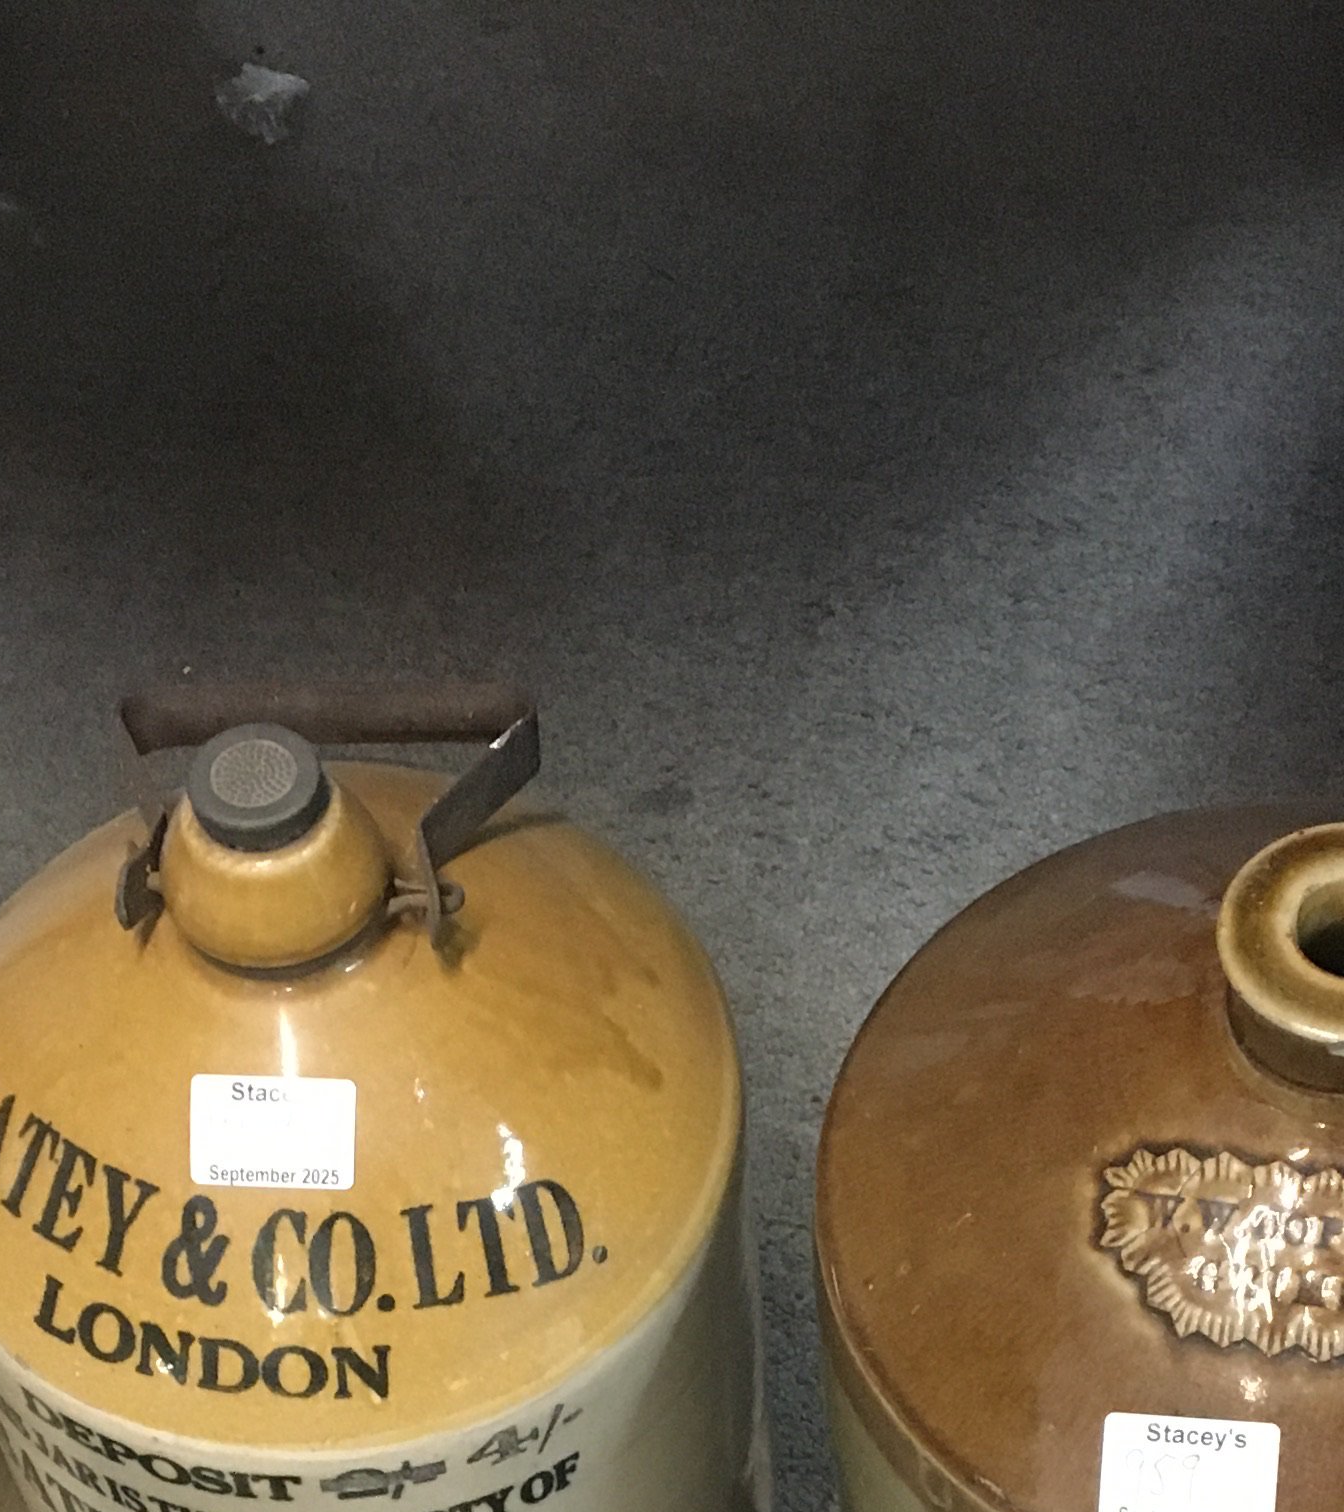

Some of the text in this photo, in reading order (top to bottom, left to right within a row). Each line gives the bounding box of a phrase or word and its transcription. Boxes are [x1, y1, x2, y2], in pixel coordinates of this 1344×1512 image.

[209, 1164, 340, 1187] September 2025
[162, 1194, 232, 1309] &
[252, 1207, 397, 1318] CO.
[400, 1178, 608, 1311] LTD.
[33, 1275, 392, 1400] LONDON
[20, 1384, 302, 1502] DEPOSIT
[32, 1427, 107, 1498] JAR
[519, 1451, 581, 1505] OF
[1146, 1423, 1247, 1451] Stacey's
